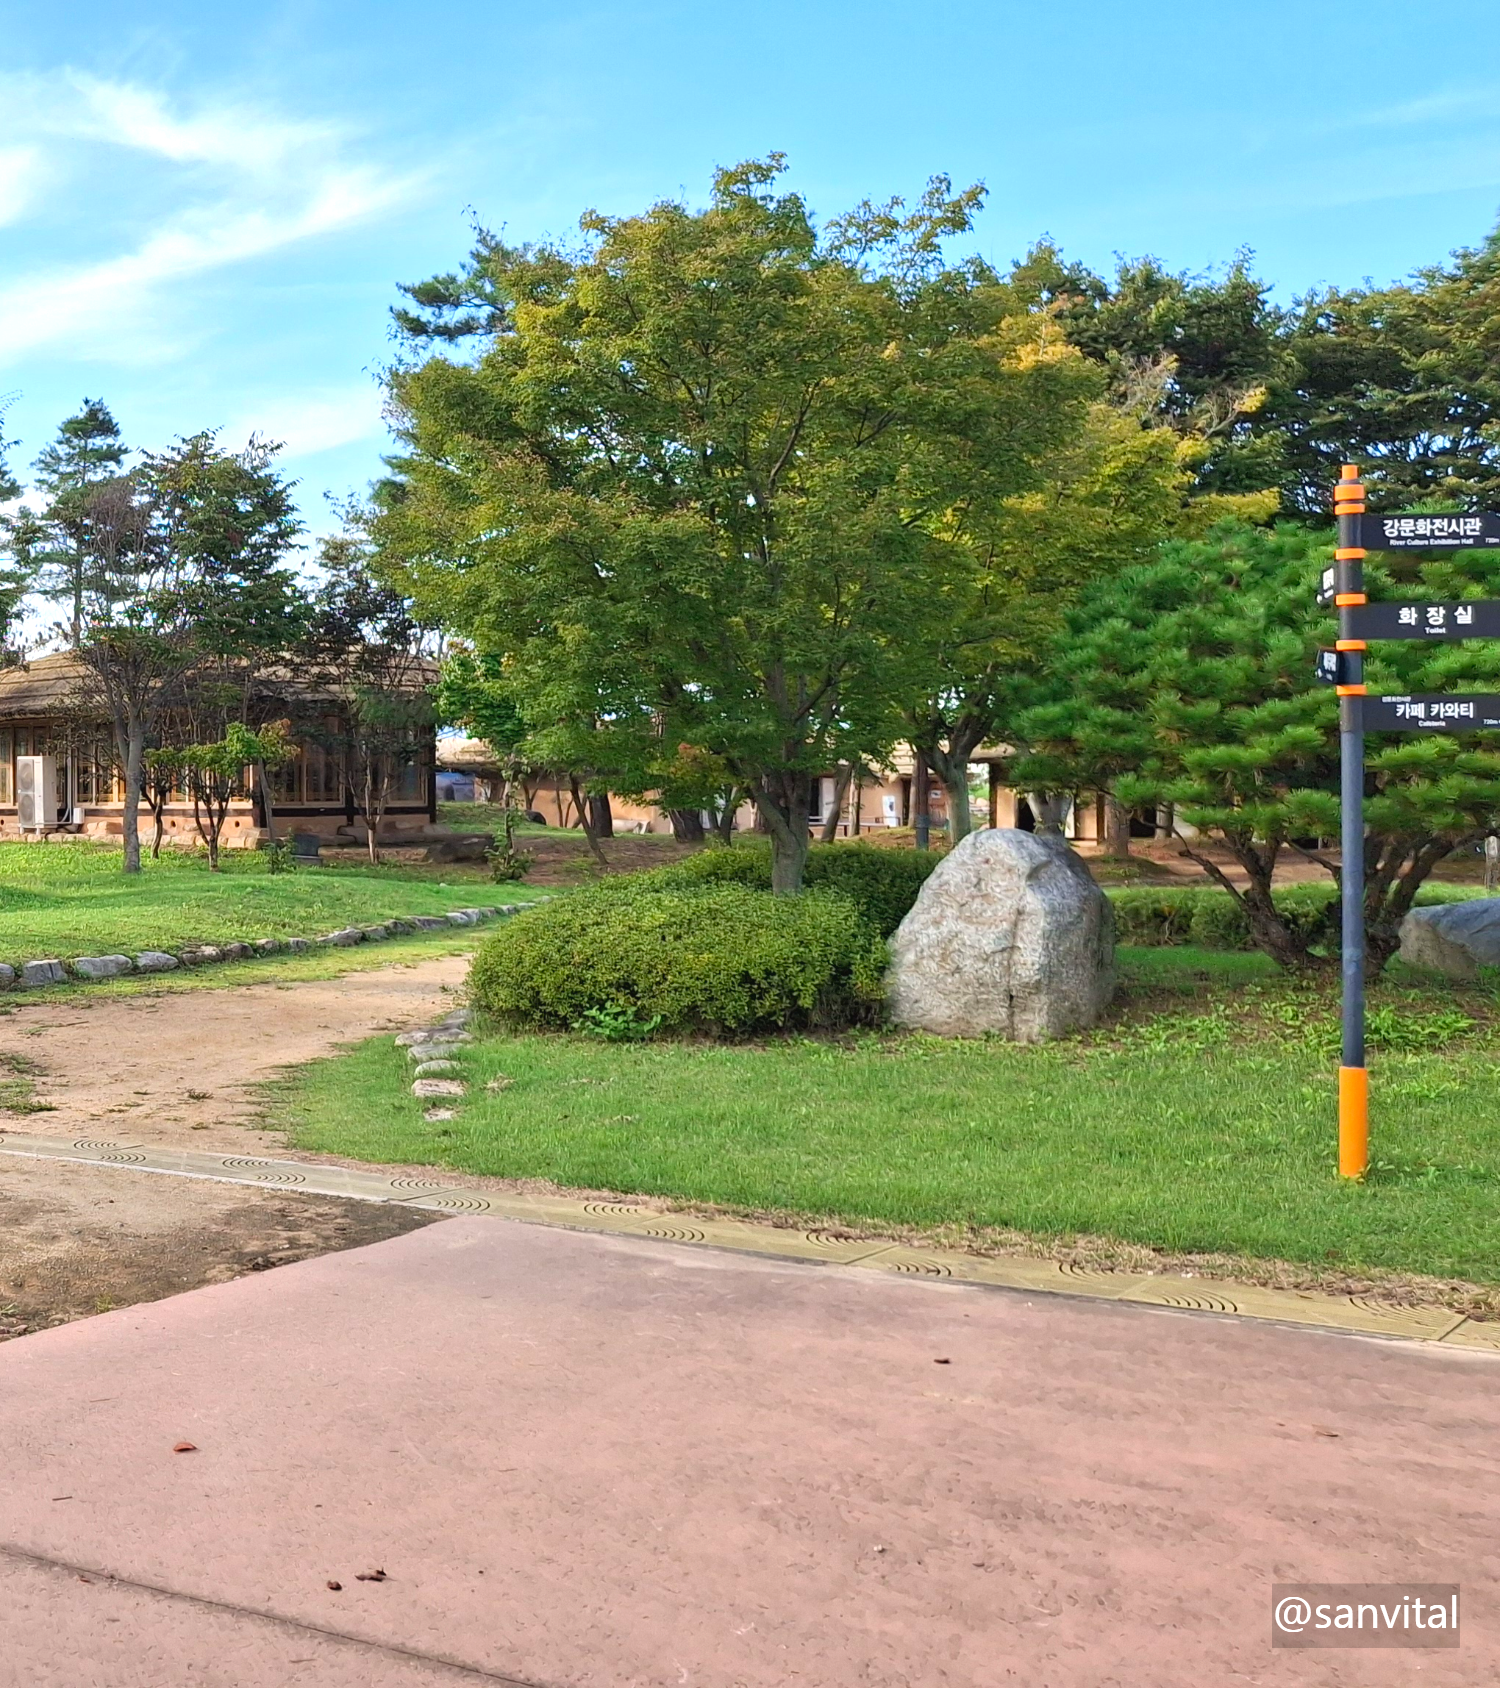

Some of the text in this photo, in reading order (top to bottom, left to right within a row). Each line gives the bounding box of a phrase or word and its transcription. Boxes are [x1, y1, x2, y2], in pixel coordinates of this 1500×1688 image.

[1383, 518, 1482, 537] 강문화전시관
[1407, 538, 1429, 546] Culture
[1429, 537, 1461, 545] Exhibition
[1461, 537, 1474, 545] Hall
[1398, 605, 1473, 626] 화 장 실
[1395, 702, 1474, 719] 카페 카와티
